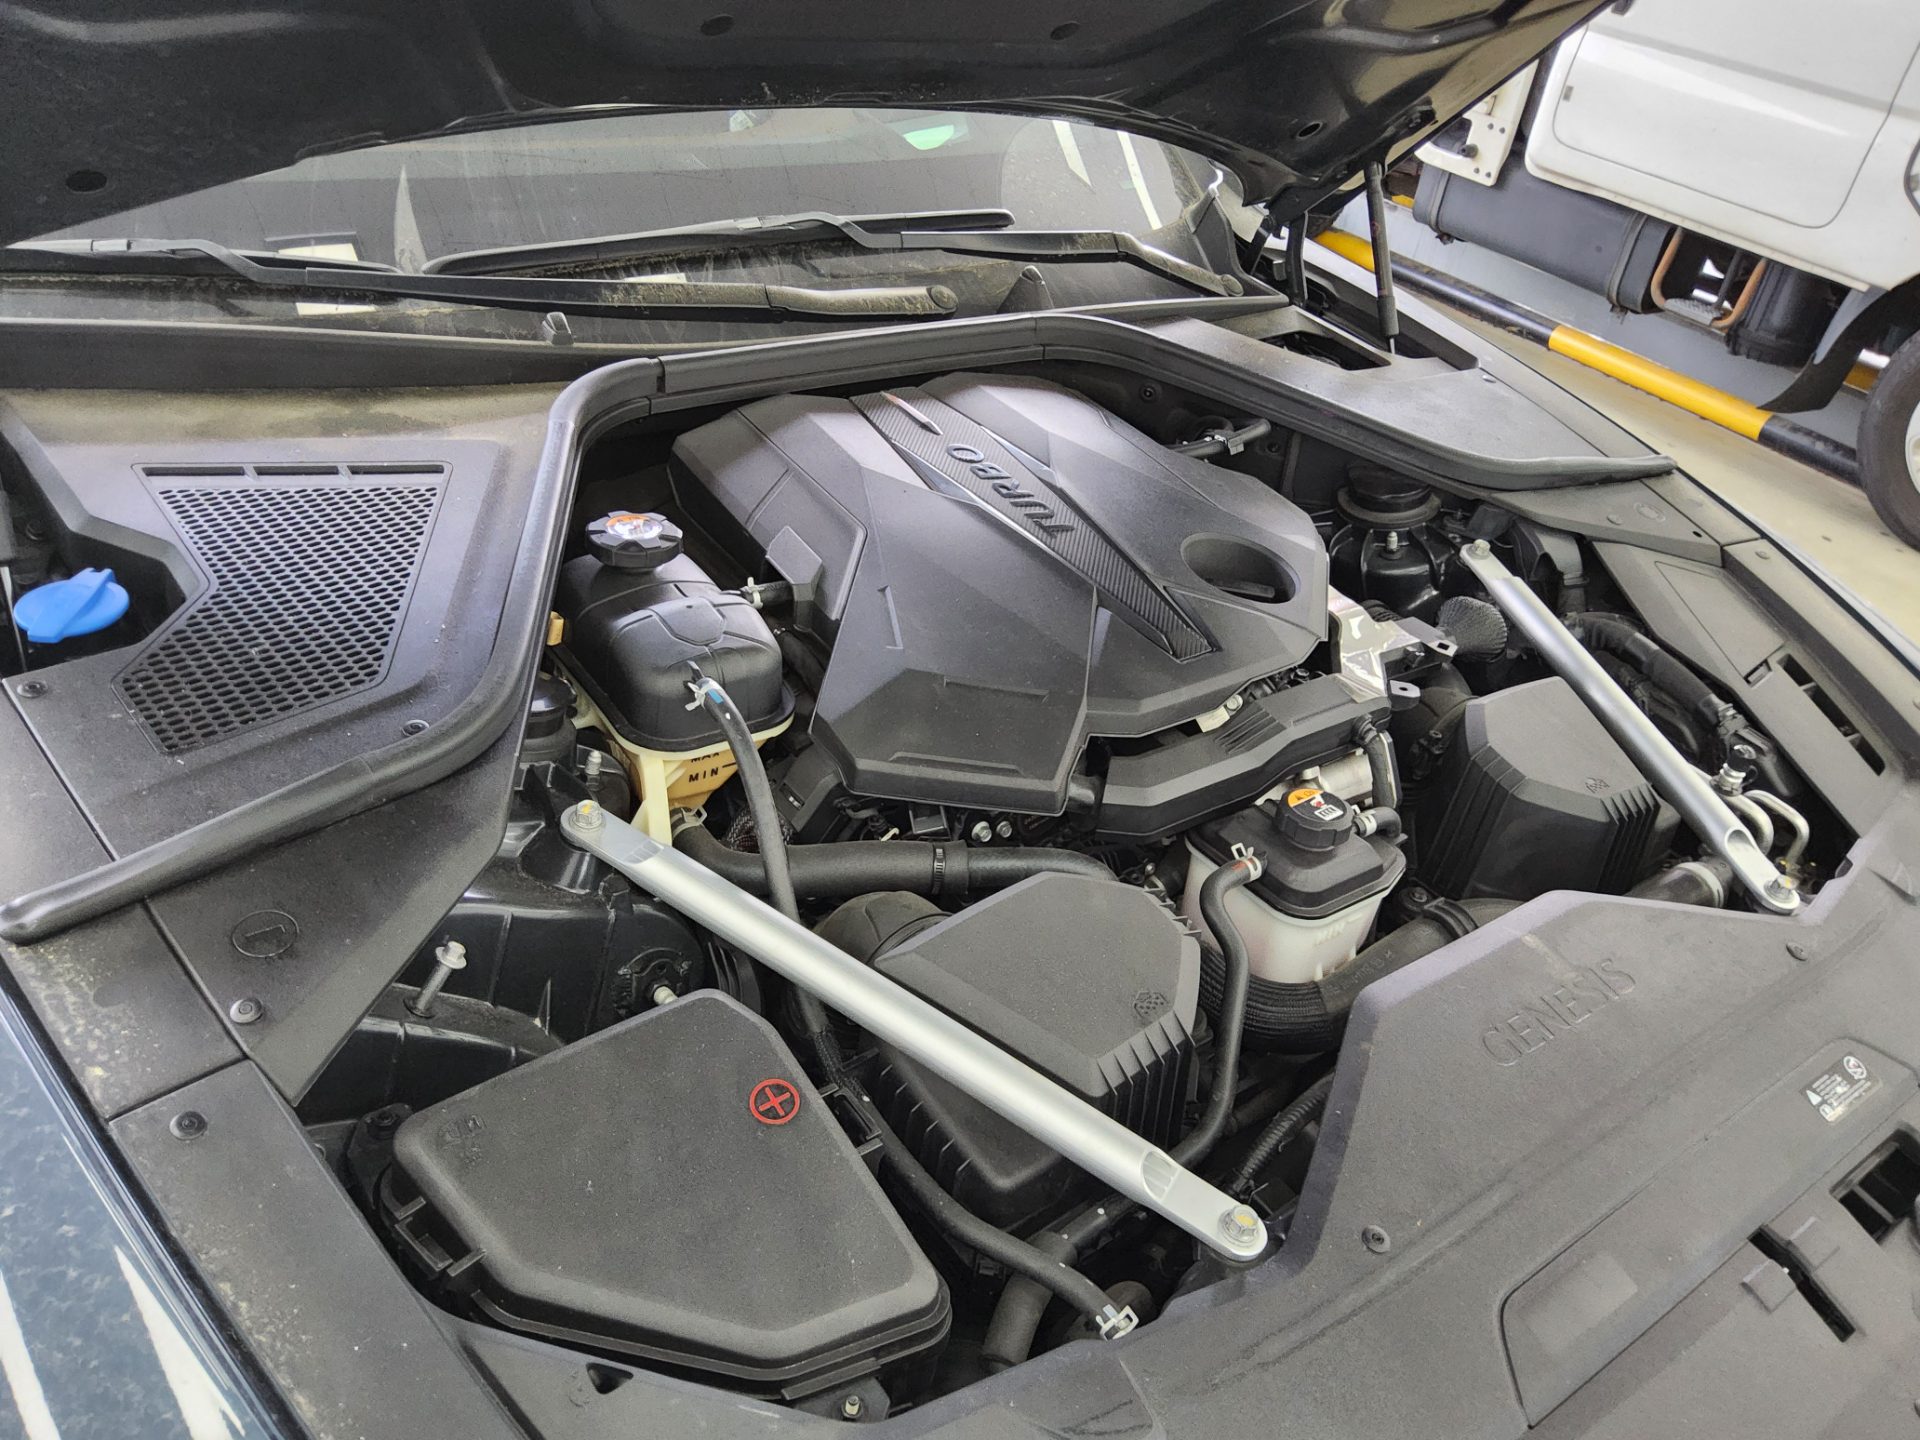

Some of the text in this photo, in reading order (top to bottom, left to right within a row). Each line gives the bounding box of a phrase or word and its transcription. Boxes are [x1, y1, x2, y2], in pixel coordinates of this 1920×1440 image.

[946, 443, 1075, 538] TURBO
[688, 767, 719, 782] MIN
[1480, 958, 1637, 1067] GENESIS
